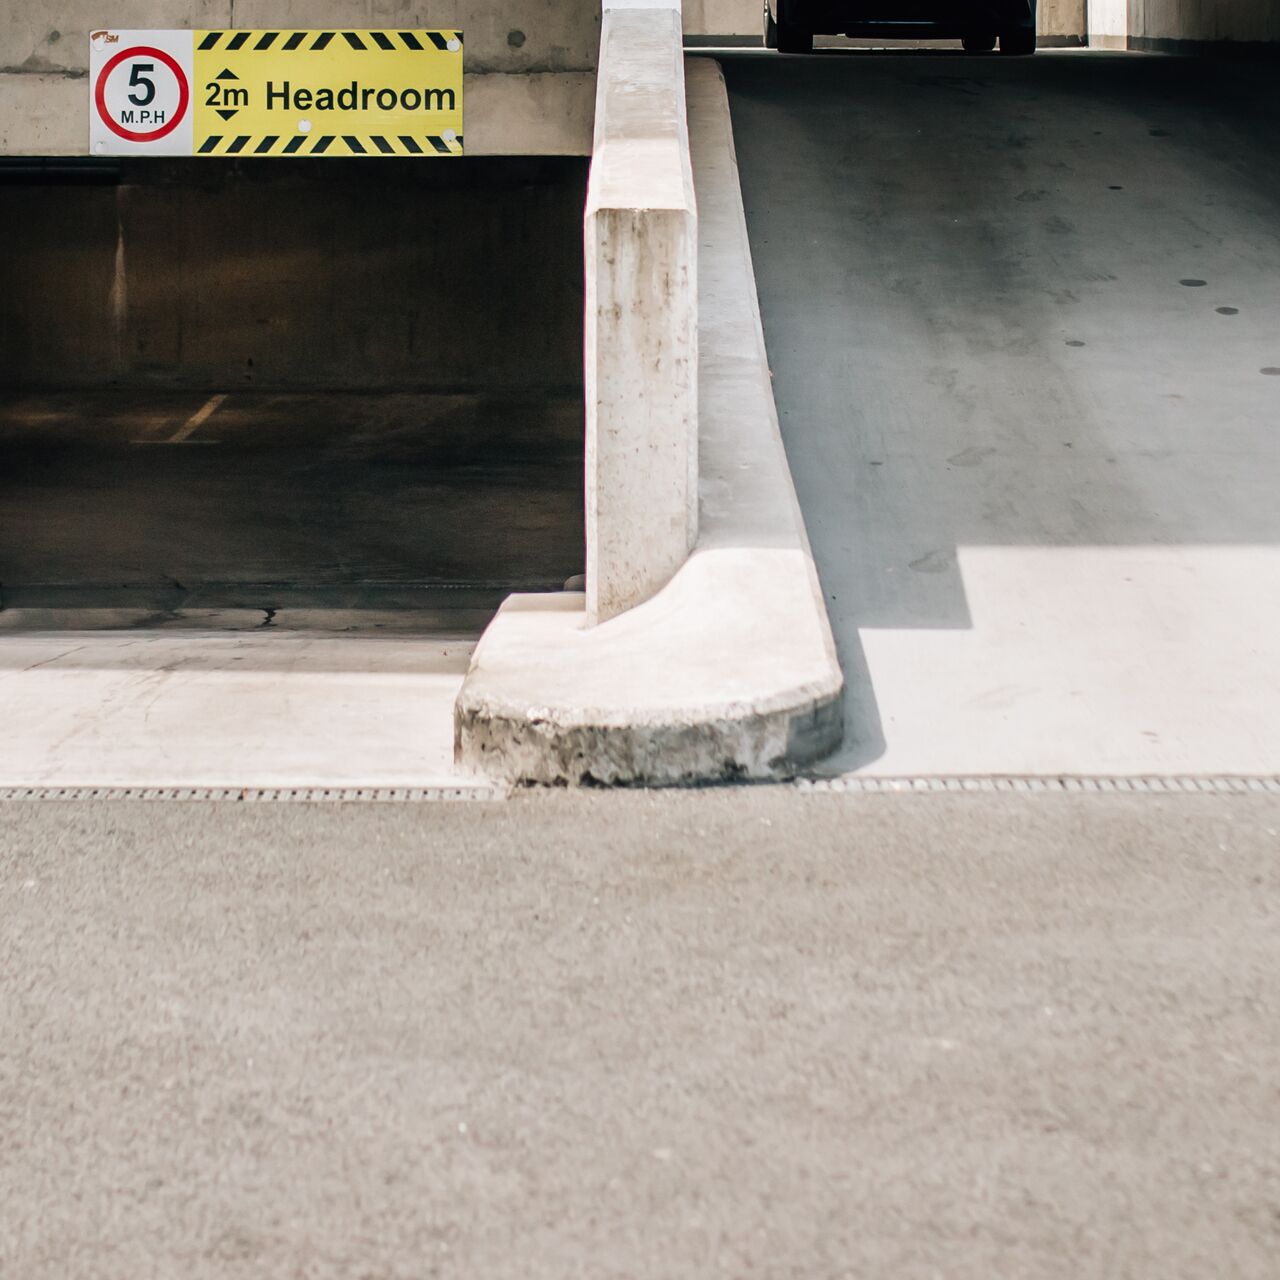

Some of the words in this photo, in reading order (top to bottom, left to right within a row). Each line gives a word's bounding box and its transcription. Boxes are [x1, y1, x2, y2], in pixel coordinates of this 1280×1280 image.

[128, 64, 156, 106] 5
[205, 82, 248, 106] 2m
[266, 81, 455, 110] Headroom
[121, 110, 165, 124] M.P.H
